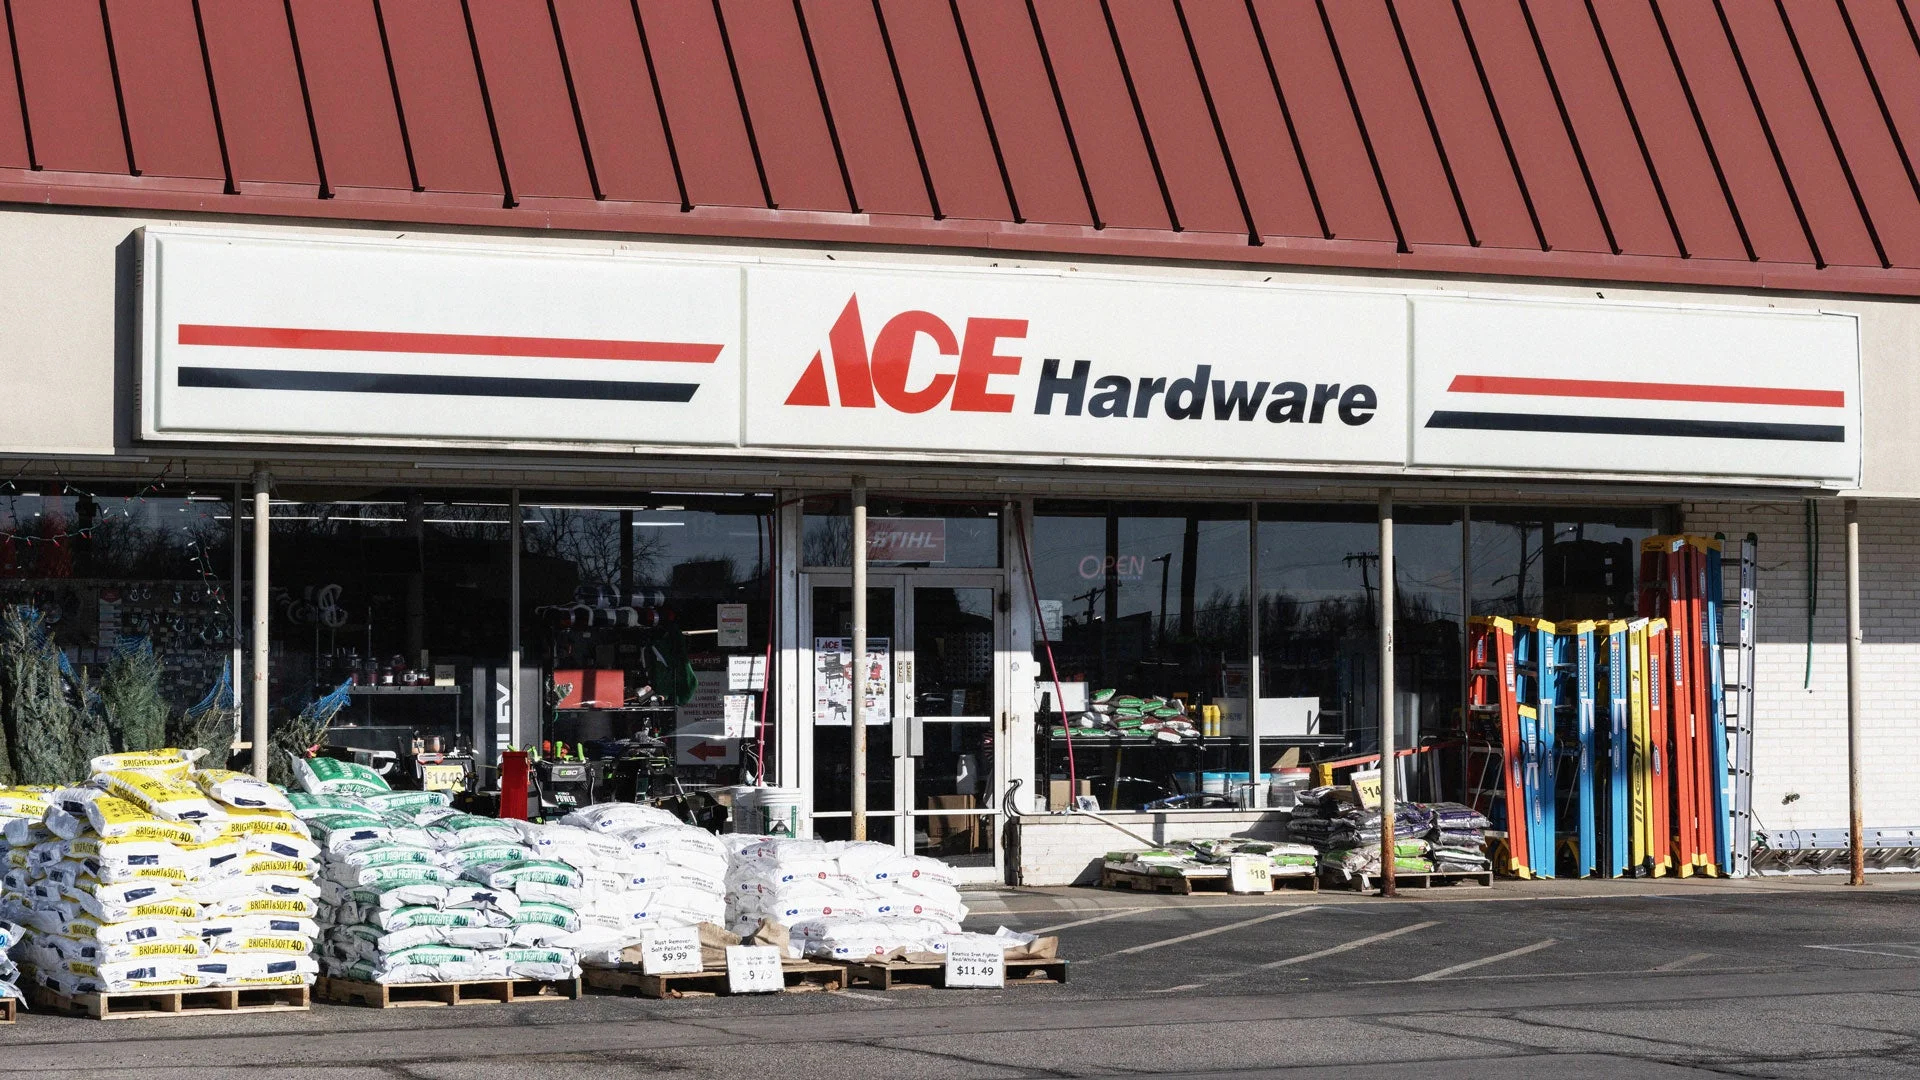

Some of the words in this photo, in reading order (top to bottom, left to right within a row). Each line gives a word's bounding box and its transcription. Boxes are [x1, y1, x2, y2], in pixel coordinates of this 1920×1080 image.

[784, 291, 1029, 414] ACE
[1033, 357, 1378, 427] Hardware
[872, 531, 937, 548] STIHL
[1079, 555, 1146, 579] OPEN
[822, 640, 840, 649] ACE
[662, 952, 687, 962] $9.99
[957, 965, 994, 976] $11.49
